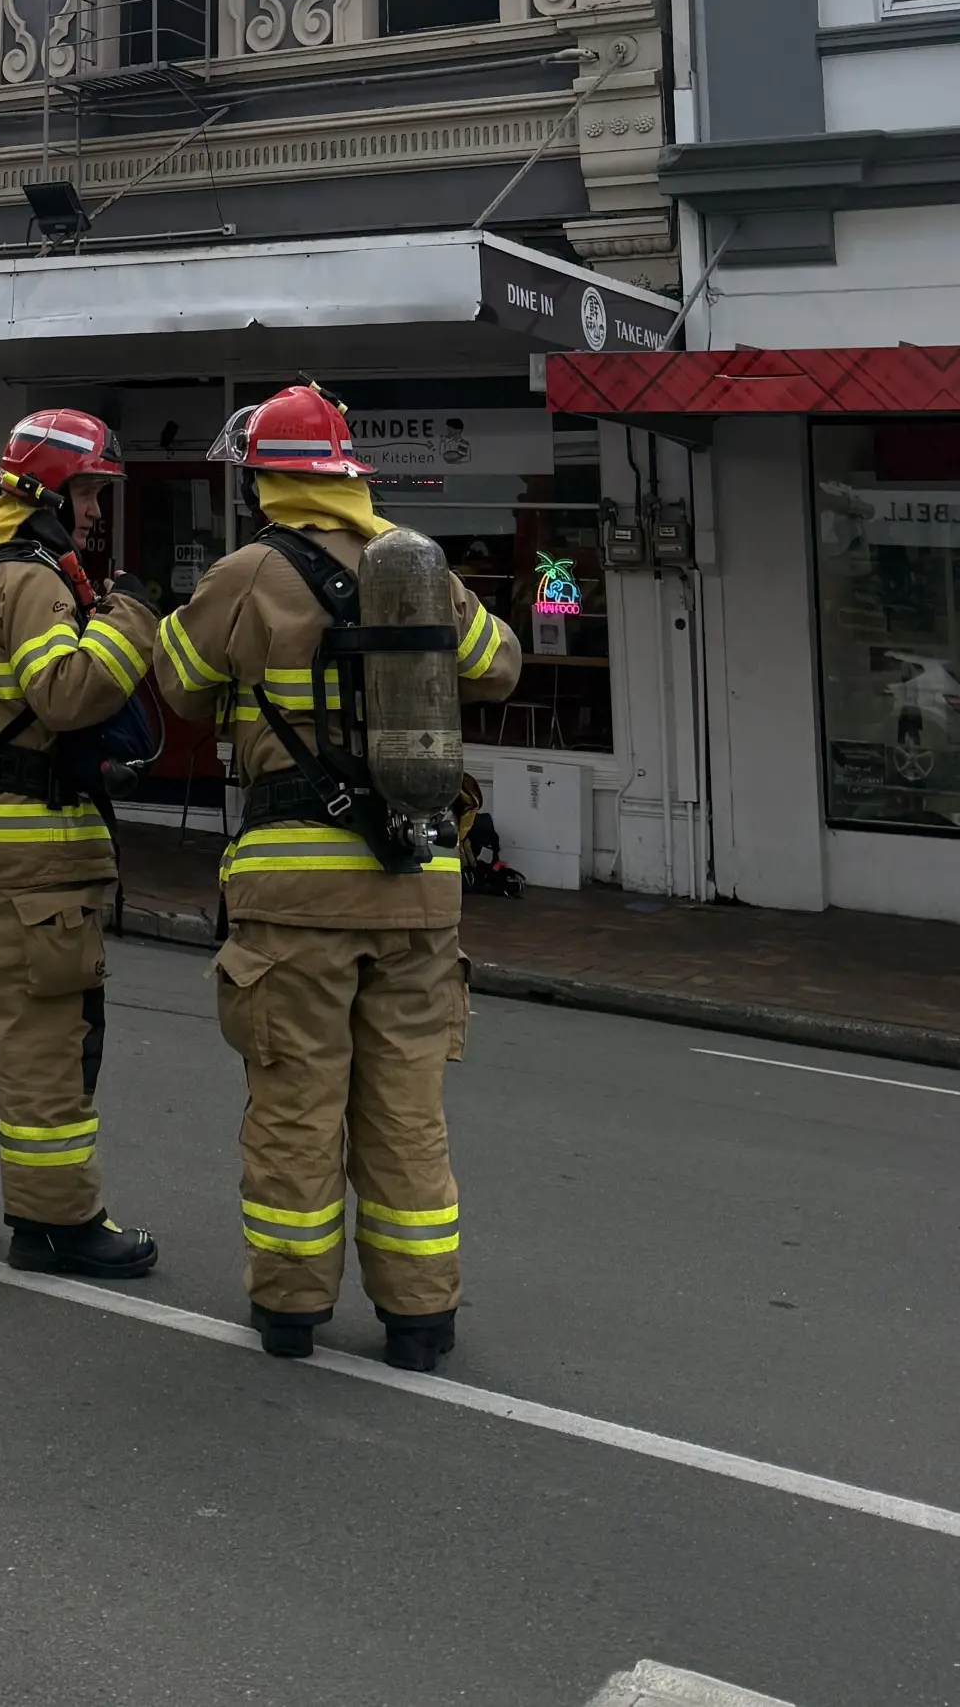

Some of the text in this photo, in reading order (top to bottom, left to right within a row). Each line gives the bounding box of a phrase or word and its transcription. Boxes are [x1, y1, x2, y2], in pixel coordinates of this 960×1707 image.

[507, 283, 554, 317] DINE IN
[614, 319, 667, 351] TAKEAWA
[346, 419, 434, 438] KINDEE
[355, 451, 435, 464] hai Kitchen
[176, 546, 202, 560] OPEN
[536, 604, 580, 614] THAI FOOD
